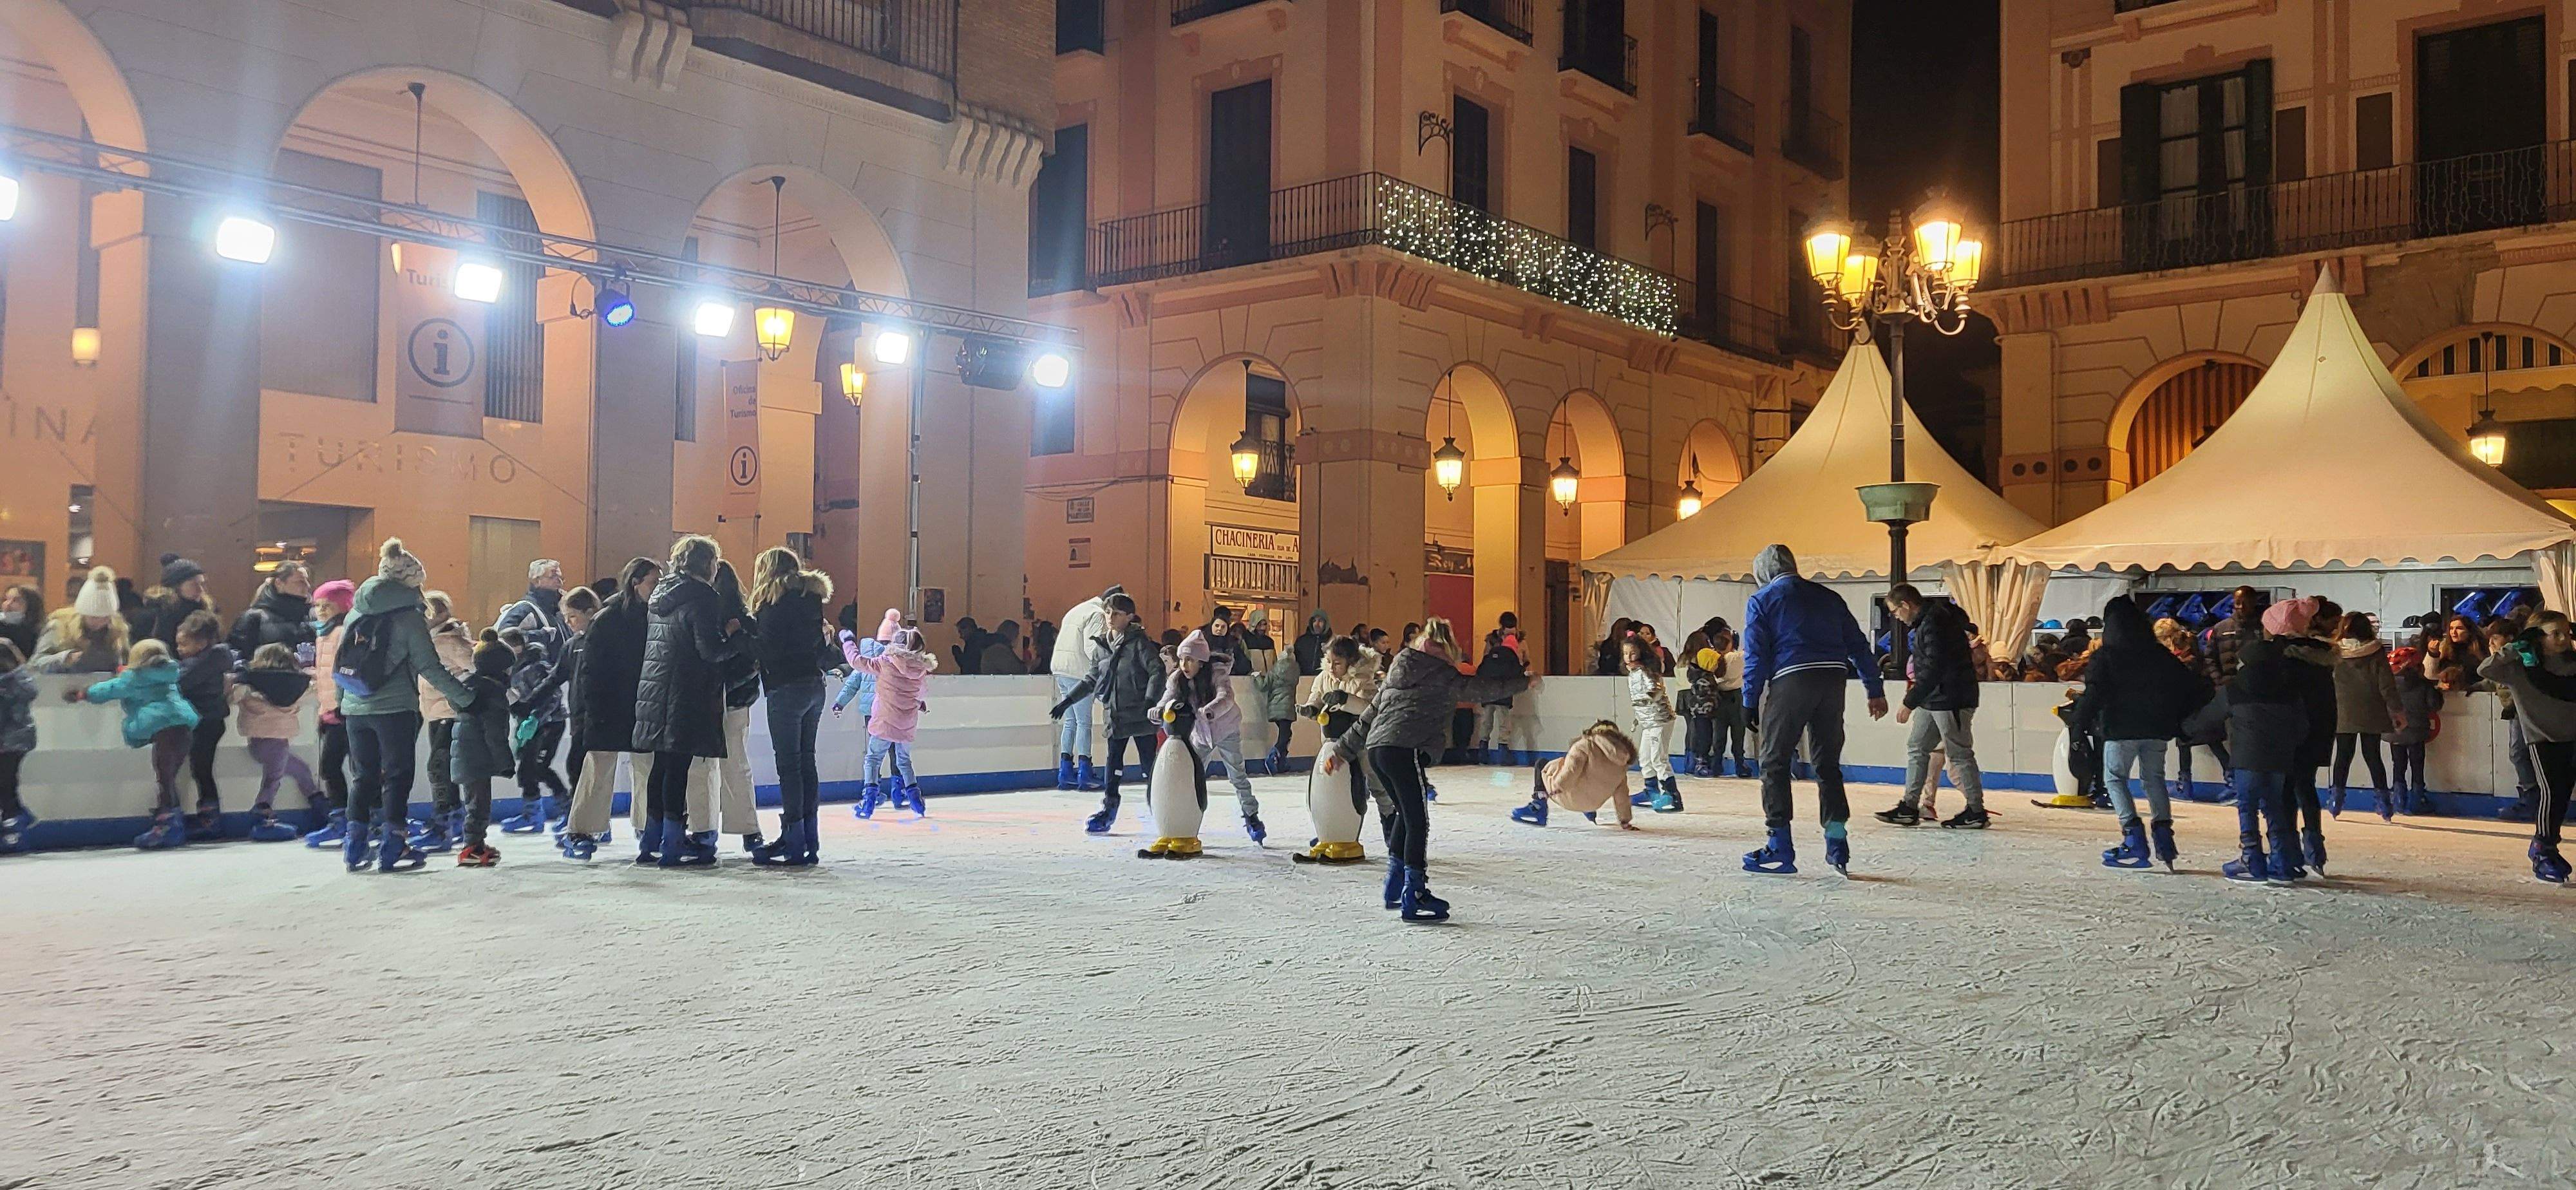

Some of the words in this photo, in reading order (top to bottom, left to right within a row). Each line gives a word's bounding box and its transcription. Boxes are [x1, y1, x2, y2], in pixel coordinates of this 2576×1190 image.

[733, 384, 756, 395] Oficina
[748, 395, 756, 405] de
[730, 408, 757, 419] Turismo
[277, 431, 516, 484] TURISMO
[1215, 528, 1275, 551] CHACINERIA
